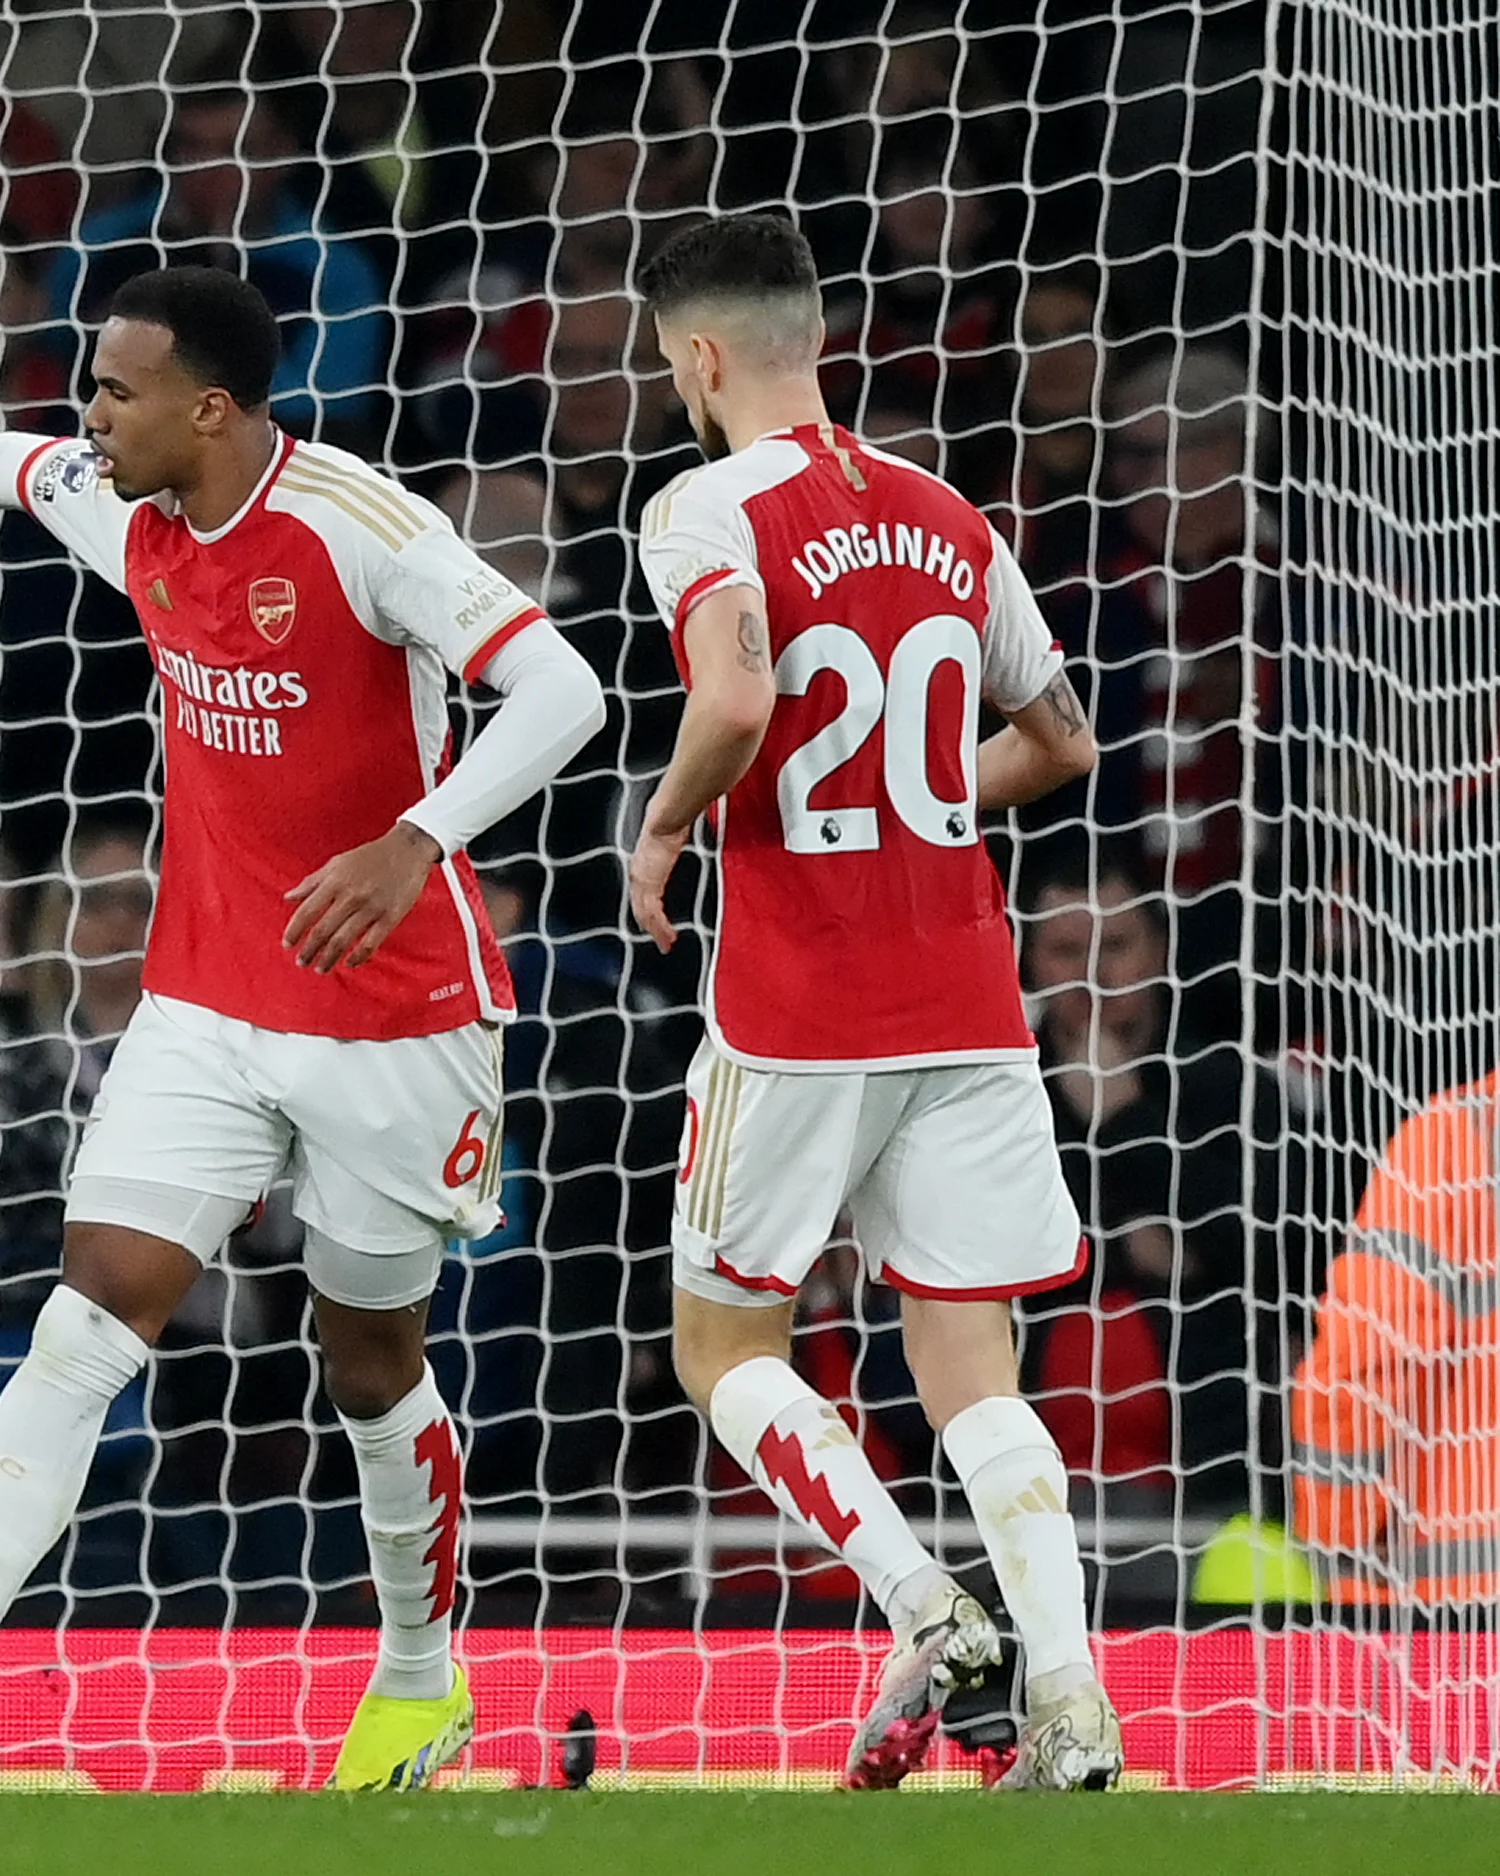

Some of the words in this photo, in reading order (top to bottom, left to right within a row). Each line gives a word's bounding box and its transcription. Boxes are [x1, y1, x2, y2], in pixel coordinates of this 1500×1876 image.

[791, 522, 975, 601] JORGINHO
[199, 707, 283, 757] BETTER
[773, 613, 983, 854] 20
[443, 1109, 484, 1189] 6
